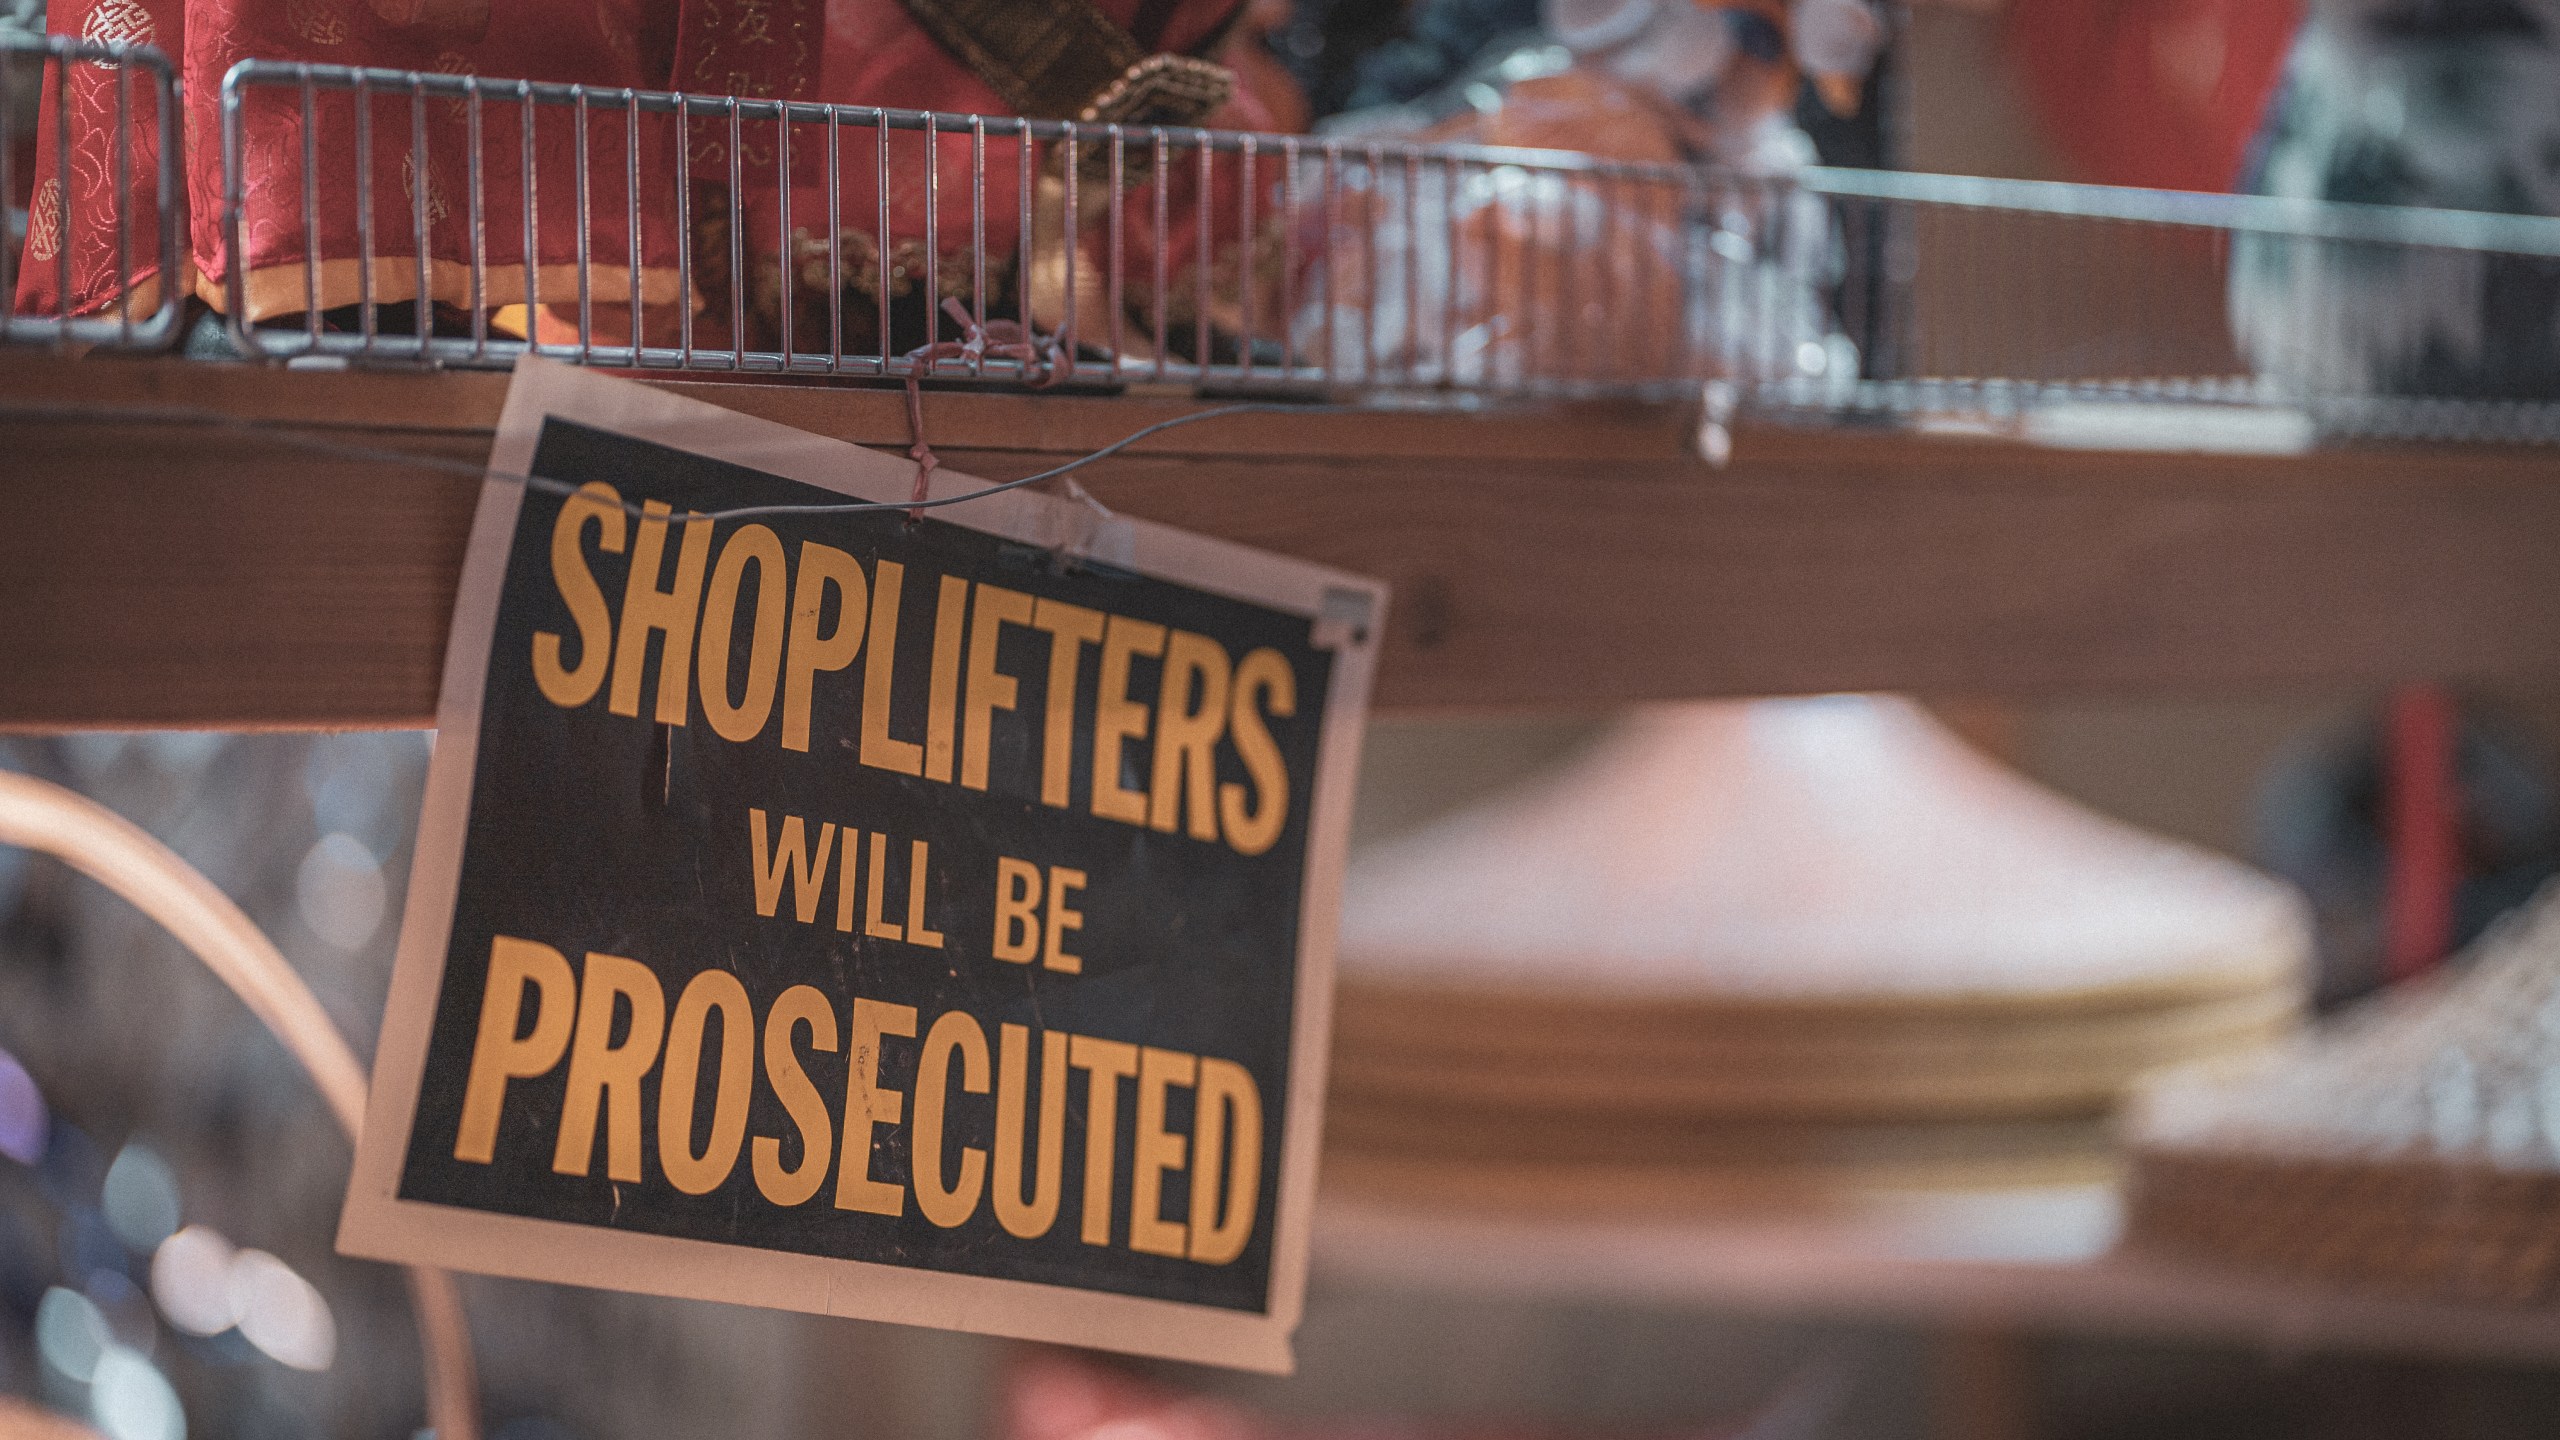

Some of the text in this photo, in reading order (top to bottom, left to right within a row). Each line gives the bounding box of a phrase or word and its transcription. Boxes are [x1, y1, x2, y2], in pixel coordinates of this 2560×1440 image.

[532, 481, 1297, 855] SHOPLIFTERS
[749, 808, 1087, 974] WILL BE
[454, 935, 1262, 1265] PROSECUTED
